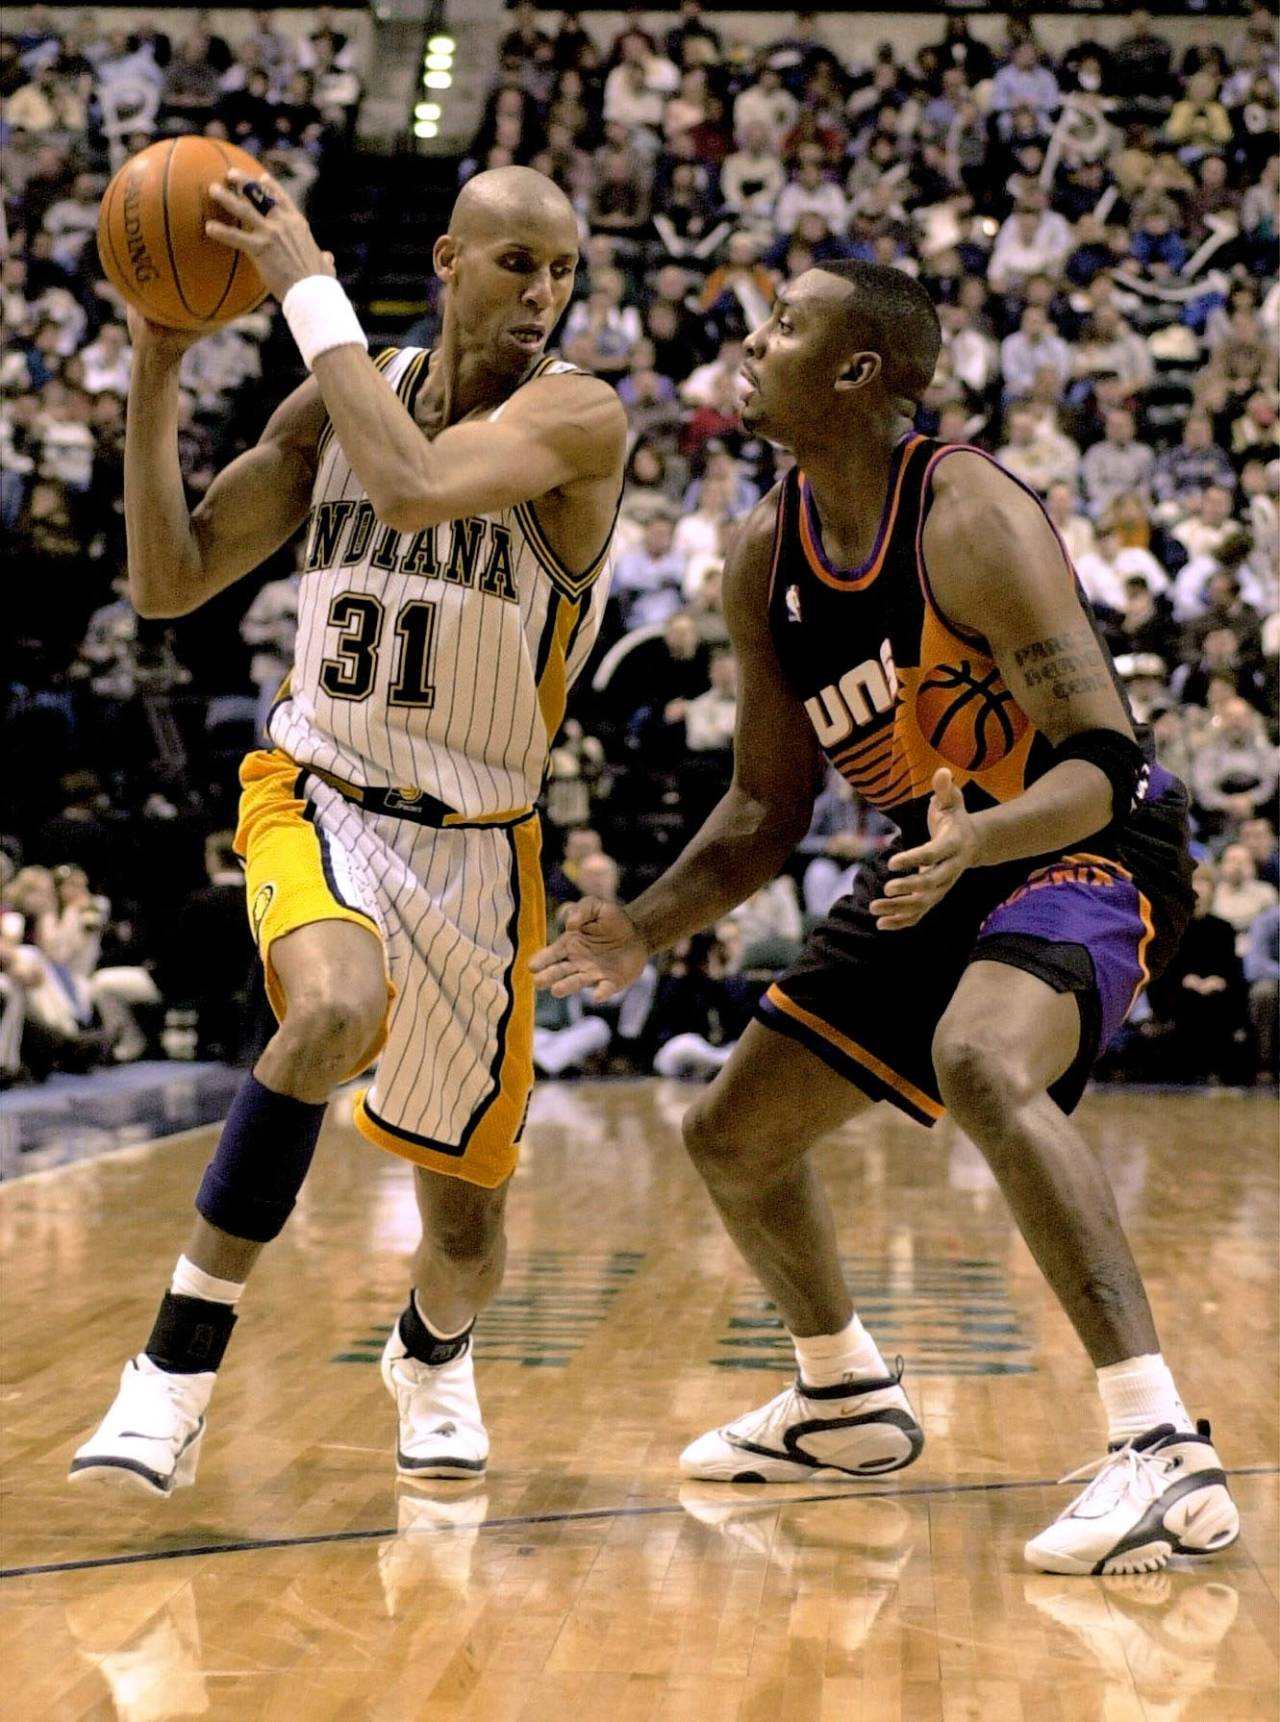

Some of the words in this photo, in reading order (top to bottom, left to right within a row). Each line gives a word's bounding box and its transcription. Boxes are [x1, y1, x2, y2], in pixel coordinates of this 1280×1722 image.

[123, 173, 160, 282] PALDING
[305, 499, 520, 605] NDIANA
[318, 590, 437, 709] 31
